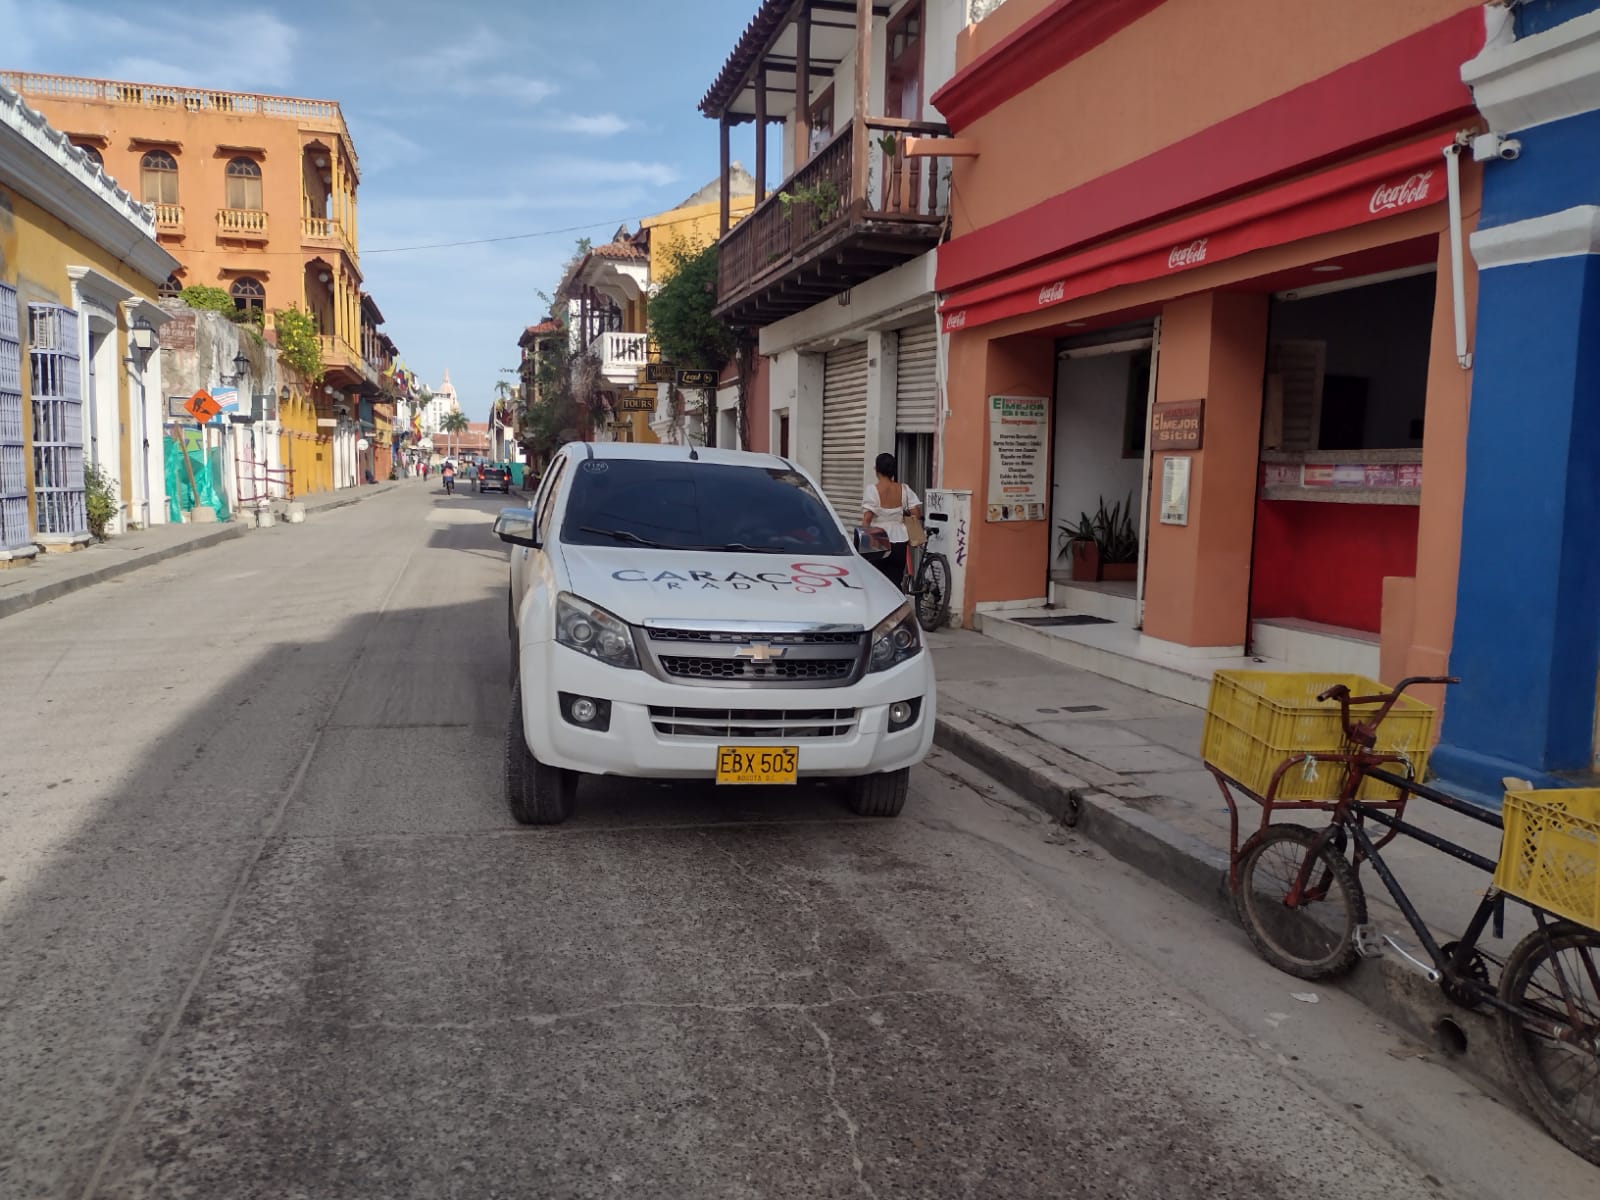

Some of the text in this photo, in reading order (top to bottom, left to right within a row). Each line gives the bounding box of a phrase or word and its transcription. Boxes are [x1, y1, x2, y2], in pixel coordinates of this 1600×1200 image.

[624, 399, 653, 409] TOURS
[1159, 431, 1197, 441] Sitio
[611, 562, 864, 590] CARACOL
[667, 582, 817, 594] RADIO
[720, 753, 795, 773] EBX 503
